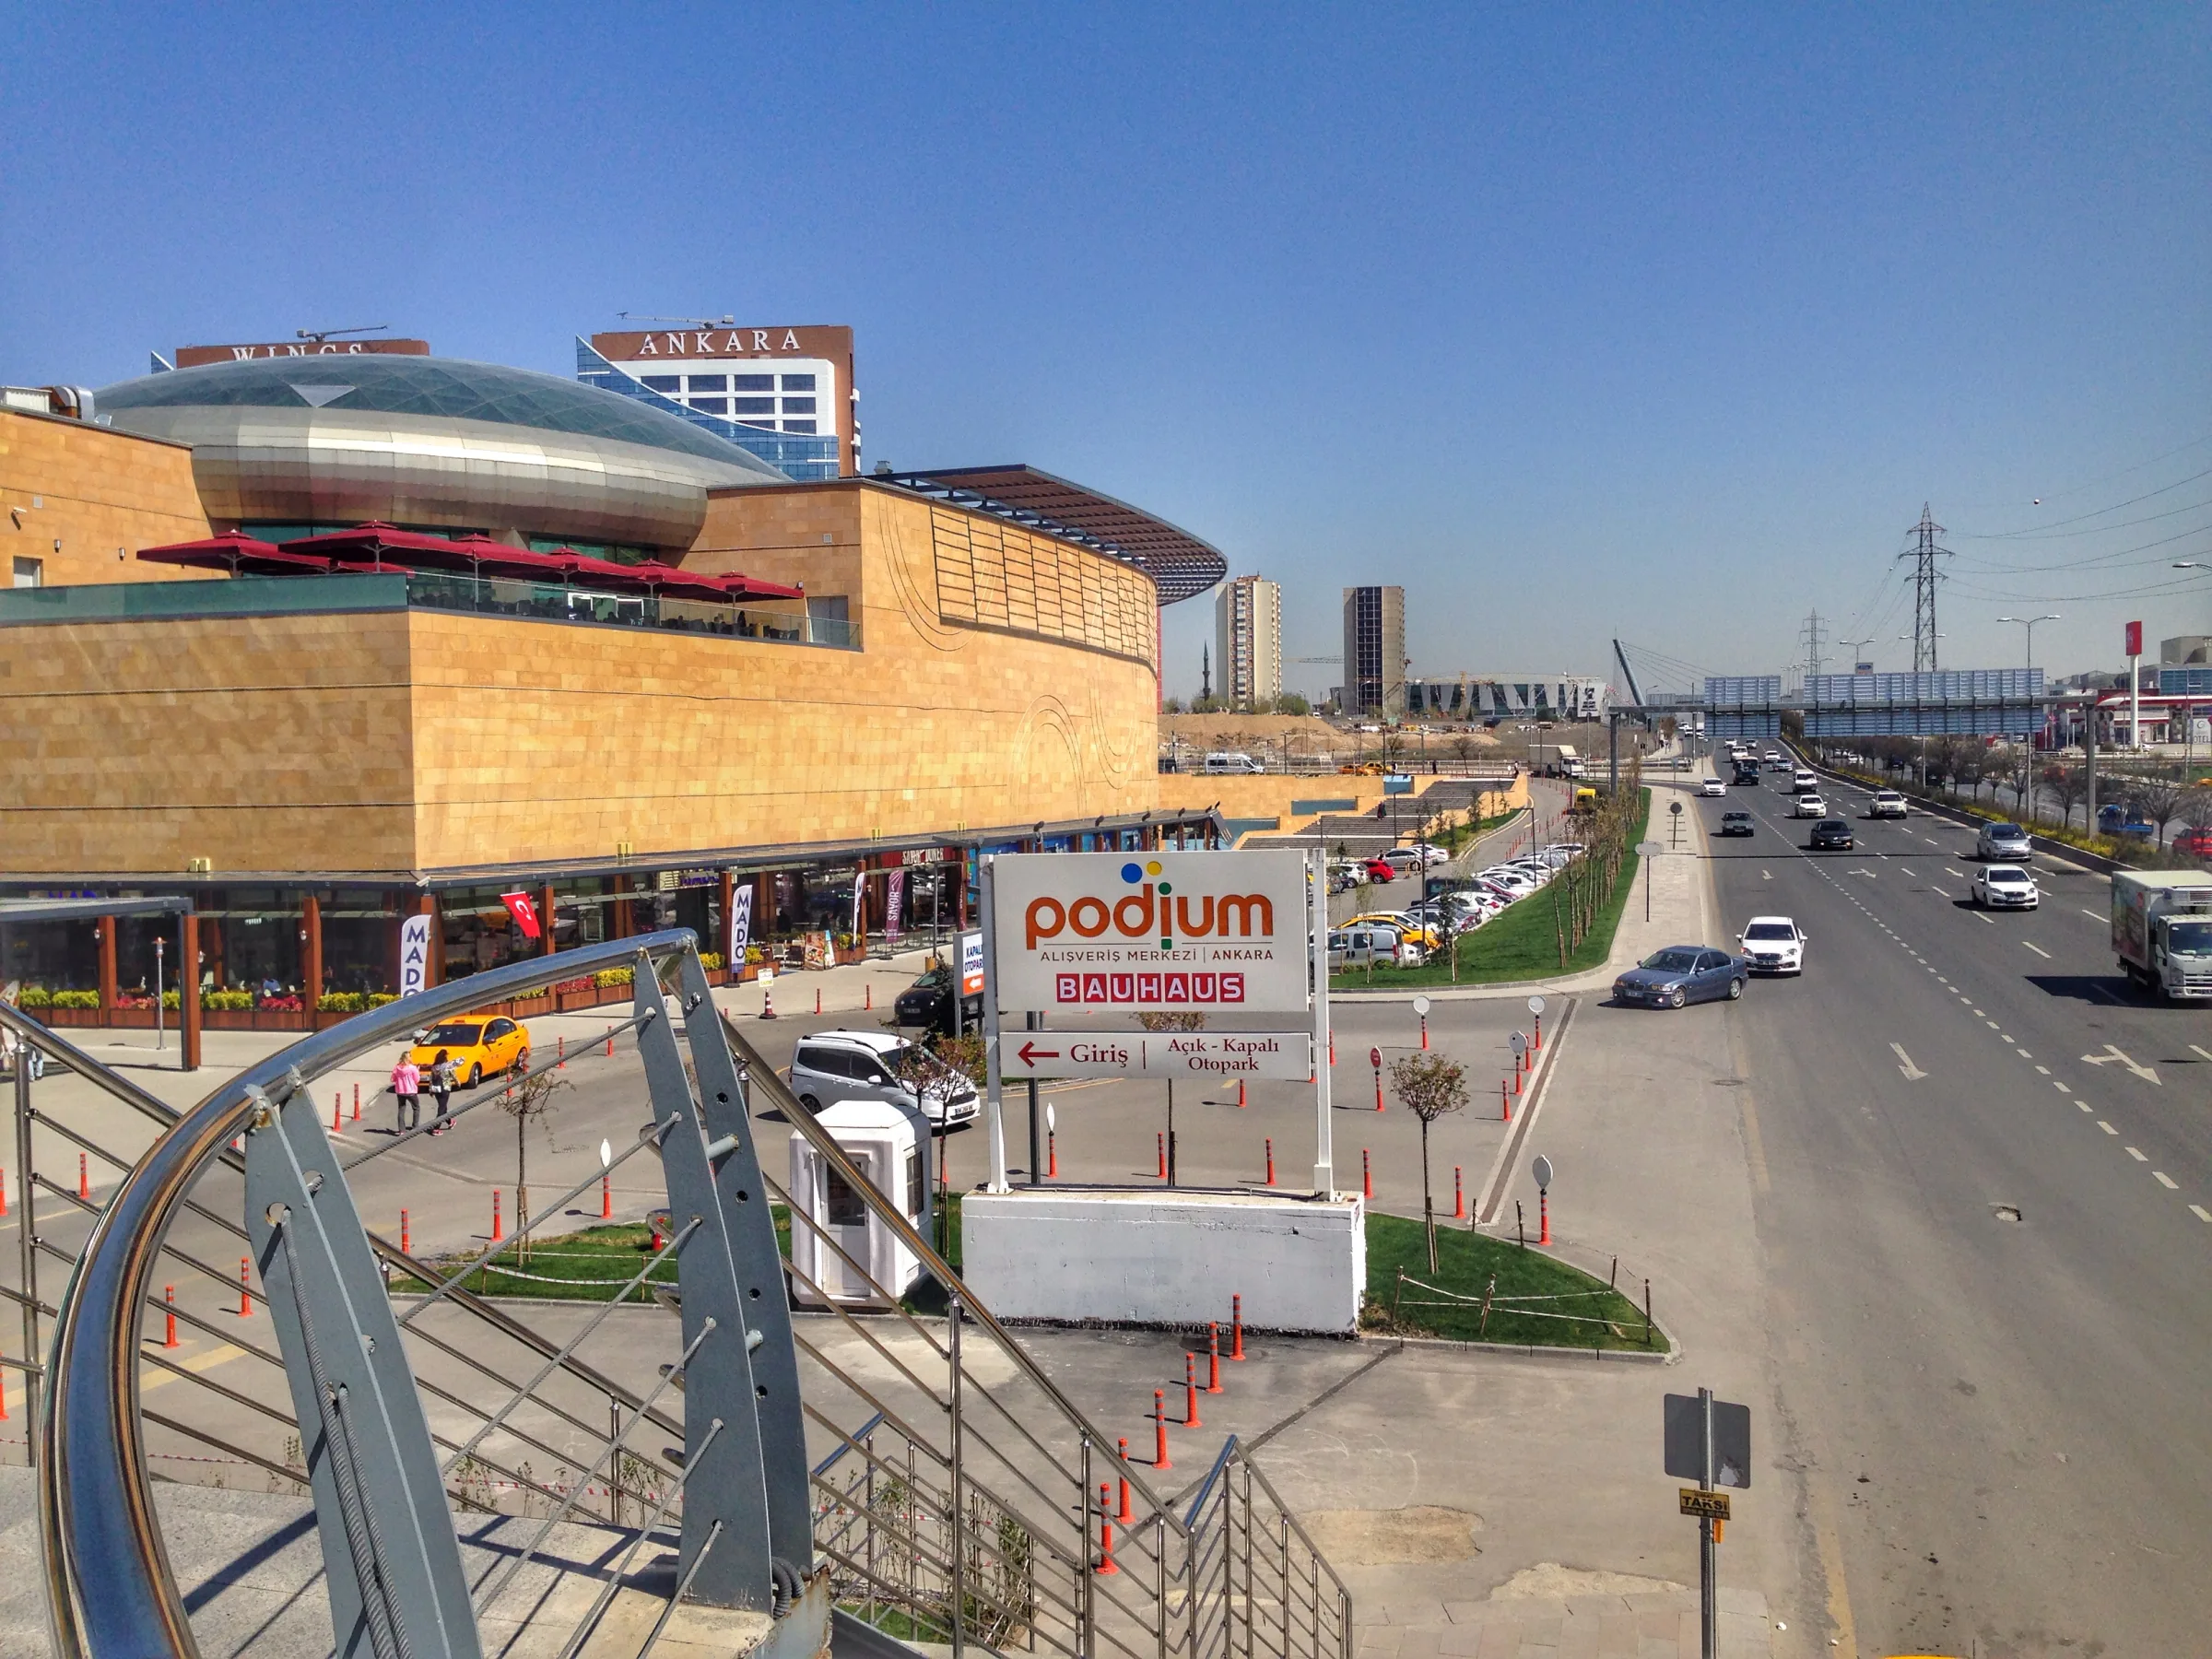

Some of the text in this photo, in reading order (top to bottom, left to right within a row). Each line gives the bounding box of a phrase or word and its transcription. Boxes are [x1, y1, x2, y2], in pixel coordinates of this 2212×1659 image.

[640, 329, 800, 355] ANKARA
[888, 891, 900, 921] SAVOR
[1025, 882, 1273, 950] podium
[735, 893, 749, 959] MADO
[965, 959, 983, 972] OTOPAR
[1041, 948, 1274, 962] ALIŞVERİŞ MERKEZİ ANKARA
[1058, 975, 1242, 1000] BAUHAUS
[1070, 1044, 1129, 1067] Giriş
[1168, 1039, 1206, 1055] Açık
[1223, 1038, 1279, 1055] Kapalı
[1188, 1056, 1260, 1075] Otopark
